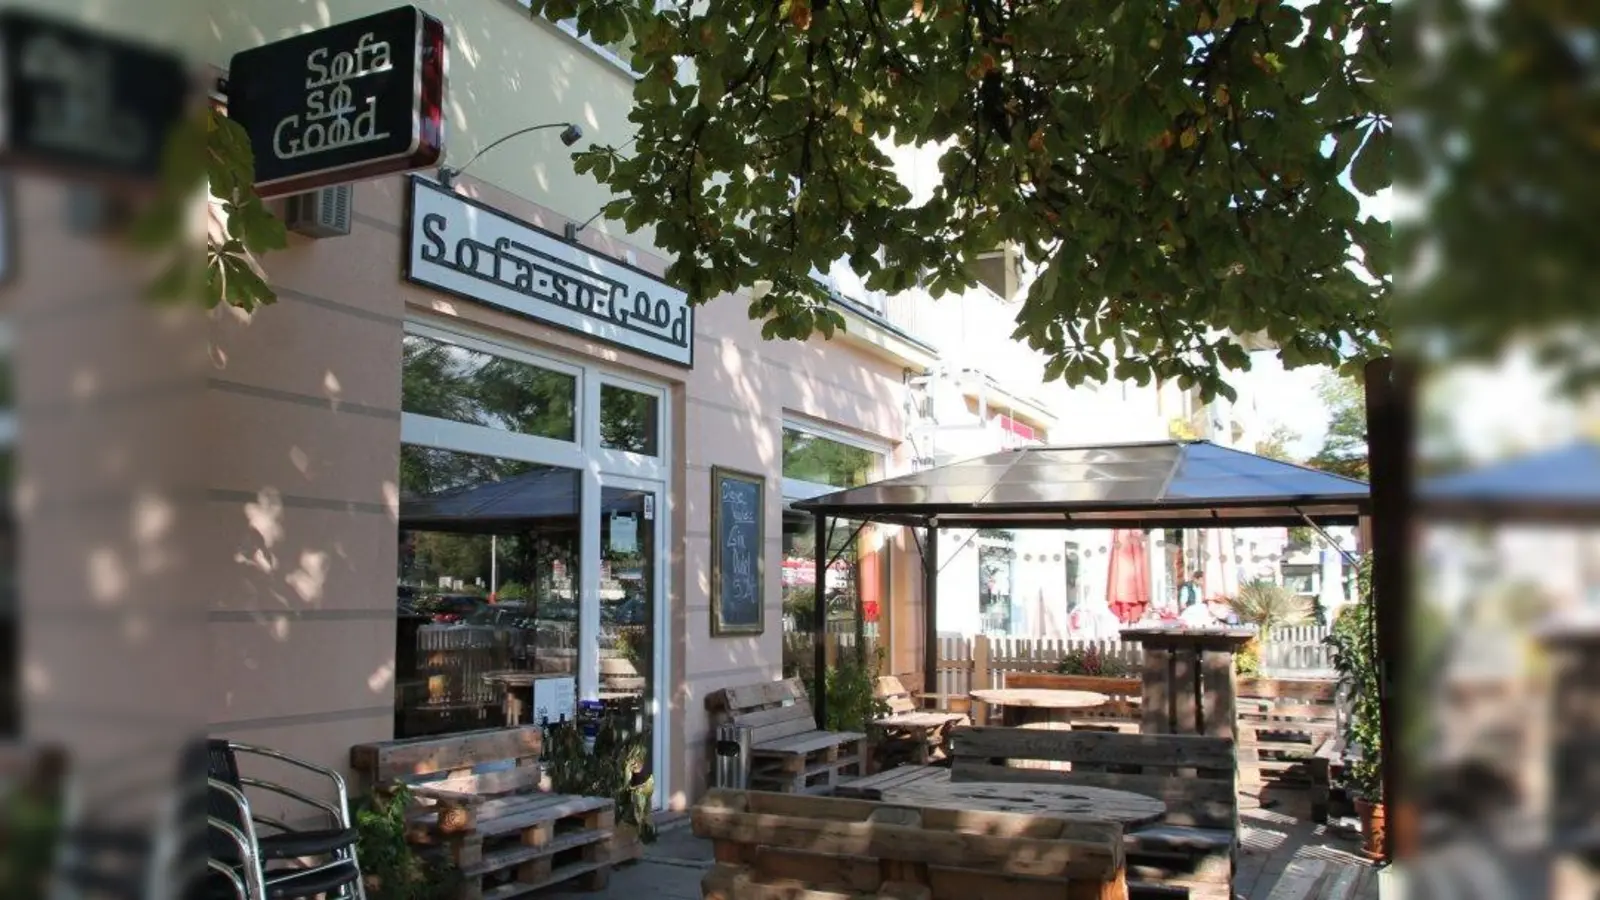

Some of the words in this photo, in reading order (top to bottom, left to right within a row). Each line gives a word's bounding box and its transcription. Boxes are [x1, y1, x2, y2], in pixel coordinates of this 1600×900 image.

[305, 32, 393, 89] Sofa
[273, 96, 390, 159] Good
[306, 84, 356, 121] so
